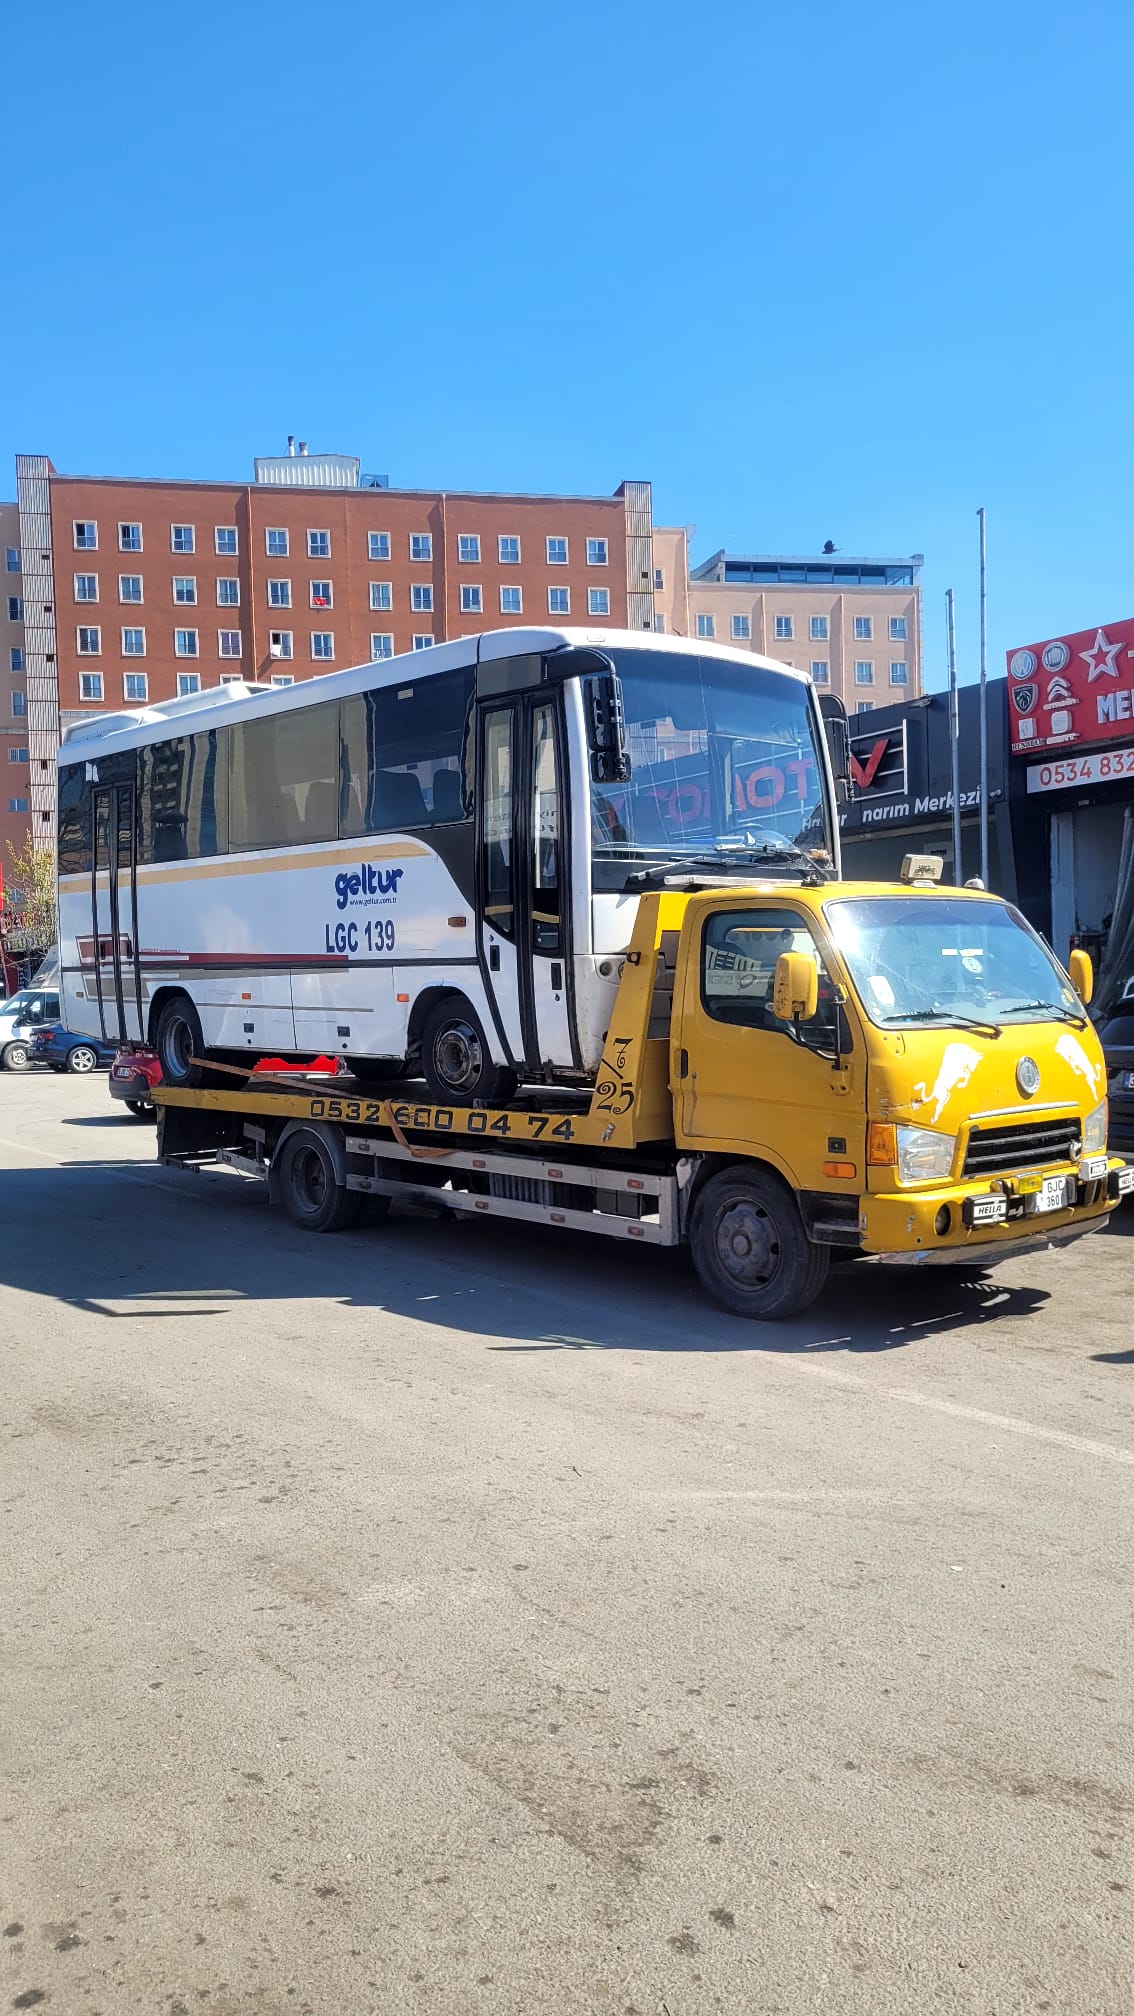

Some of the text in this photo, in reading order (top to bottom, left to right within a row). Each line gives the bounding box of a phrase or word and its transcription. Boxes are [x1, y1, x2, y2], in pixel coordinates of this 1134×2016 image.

[1097, 688, 1134, 724] ME
[1040, 751, 1134, 787] 0534 832
[335, 863, 404, 910] geltur
[350, 897, 397, 907] www.geltur.com.tr
[325, 920, 395, 953] LGC 139
[310, 1100, 380, 1123] 0532
[467, 1112, 511, 1136] 04
[527, 1116, 575, 1141] 74
[1047, 1179, 1064, 1193] GJC
[978, 1205, 1002, 1215] HELLA
